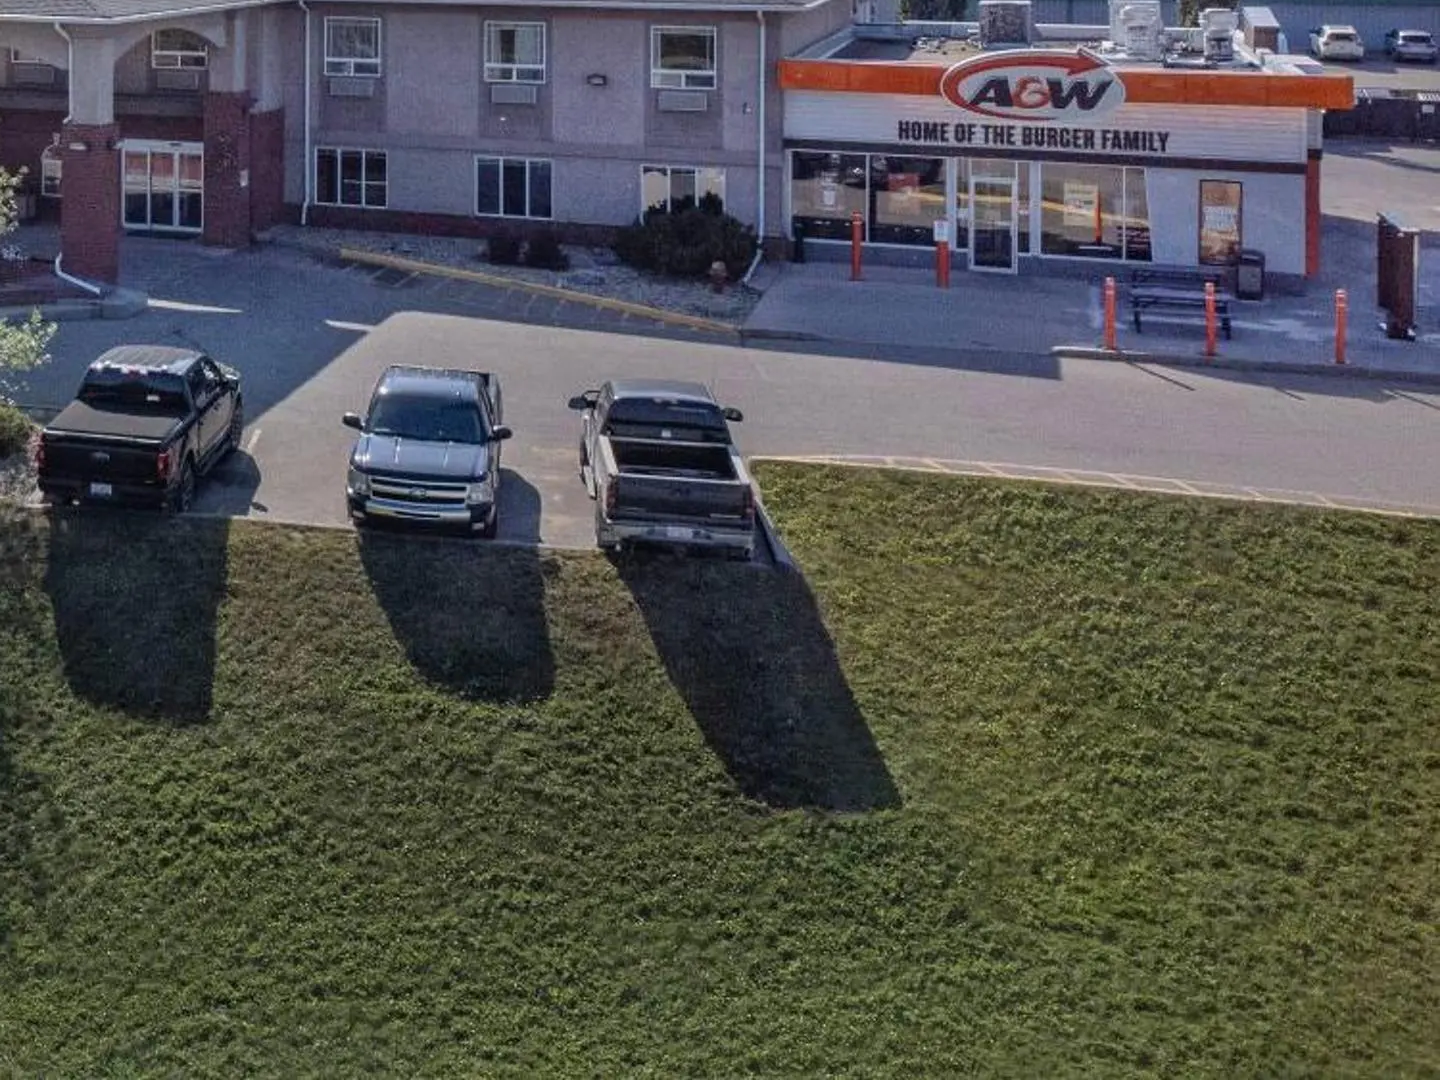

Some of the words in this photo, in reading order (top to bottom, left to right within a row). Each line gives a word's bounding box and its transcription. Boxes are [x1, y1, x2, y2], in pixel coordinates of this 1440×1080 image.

[968, 75, 1113, 111] A&W
[898, 121, 949, 142] HOME
[954, 123, 977, 144] OF
[983, 124, 1016, 146] THE
[1022, 126, 1095, 150] BURGER
[1101, 129, 1170, 152] FAMILY
